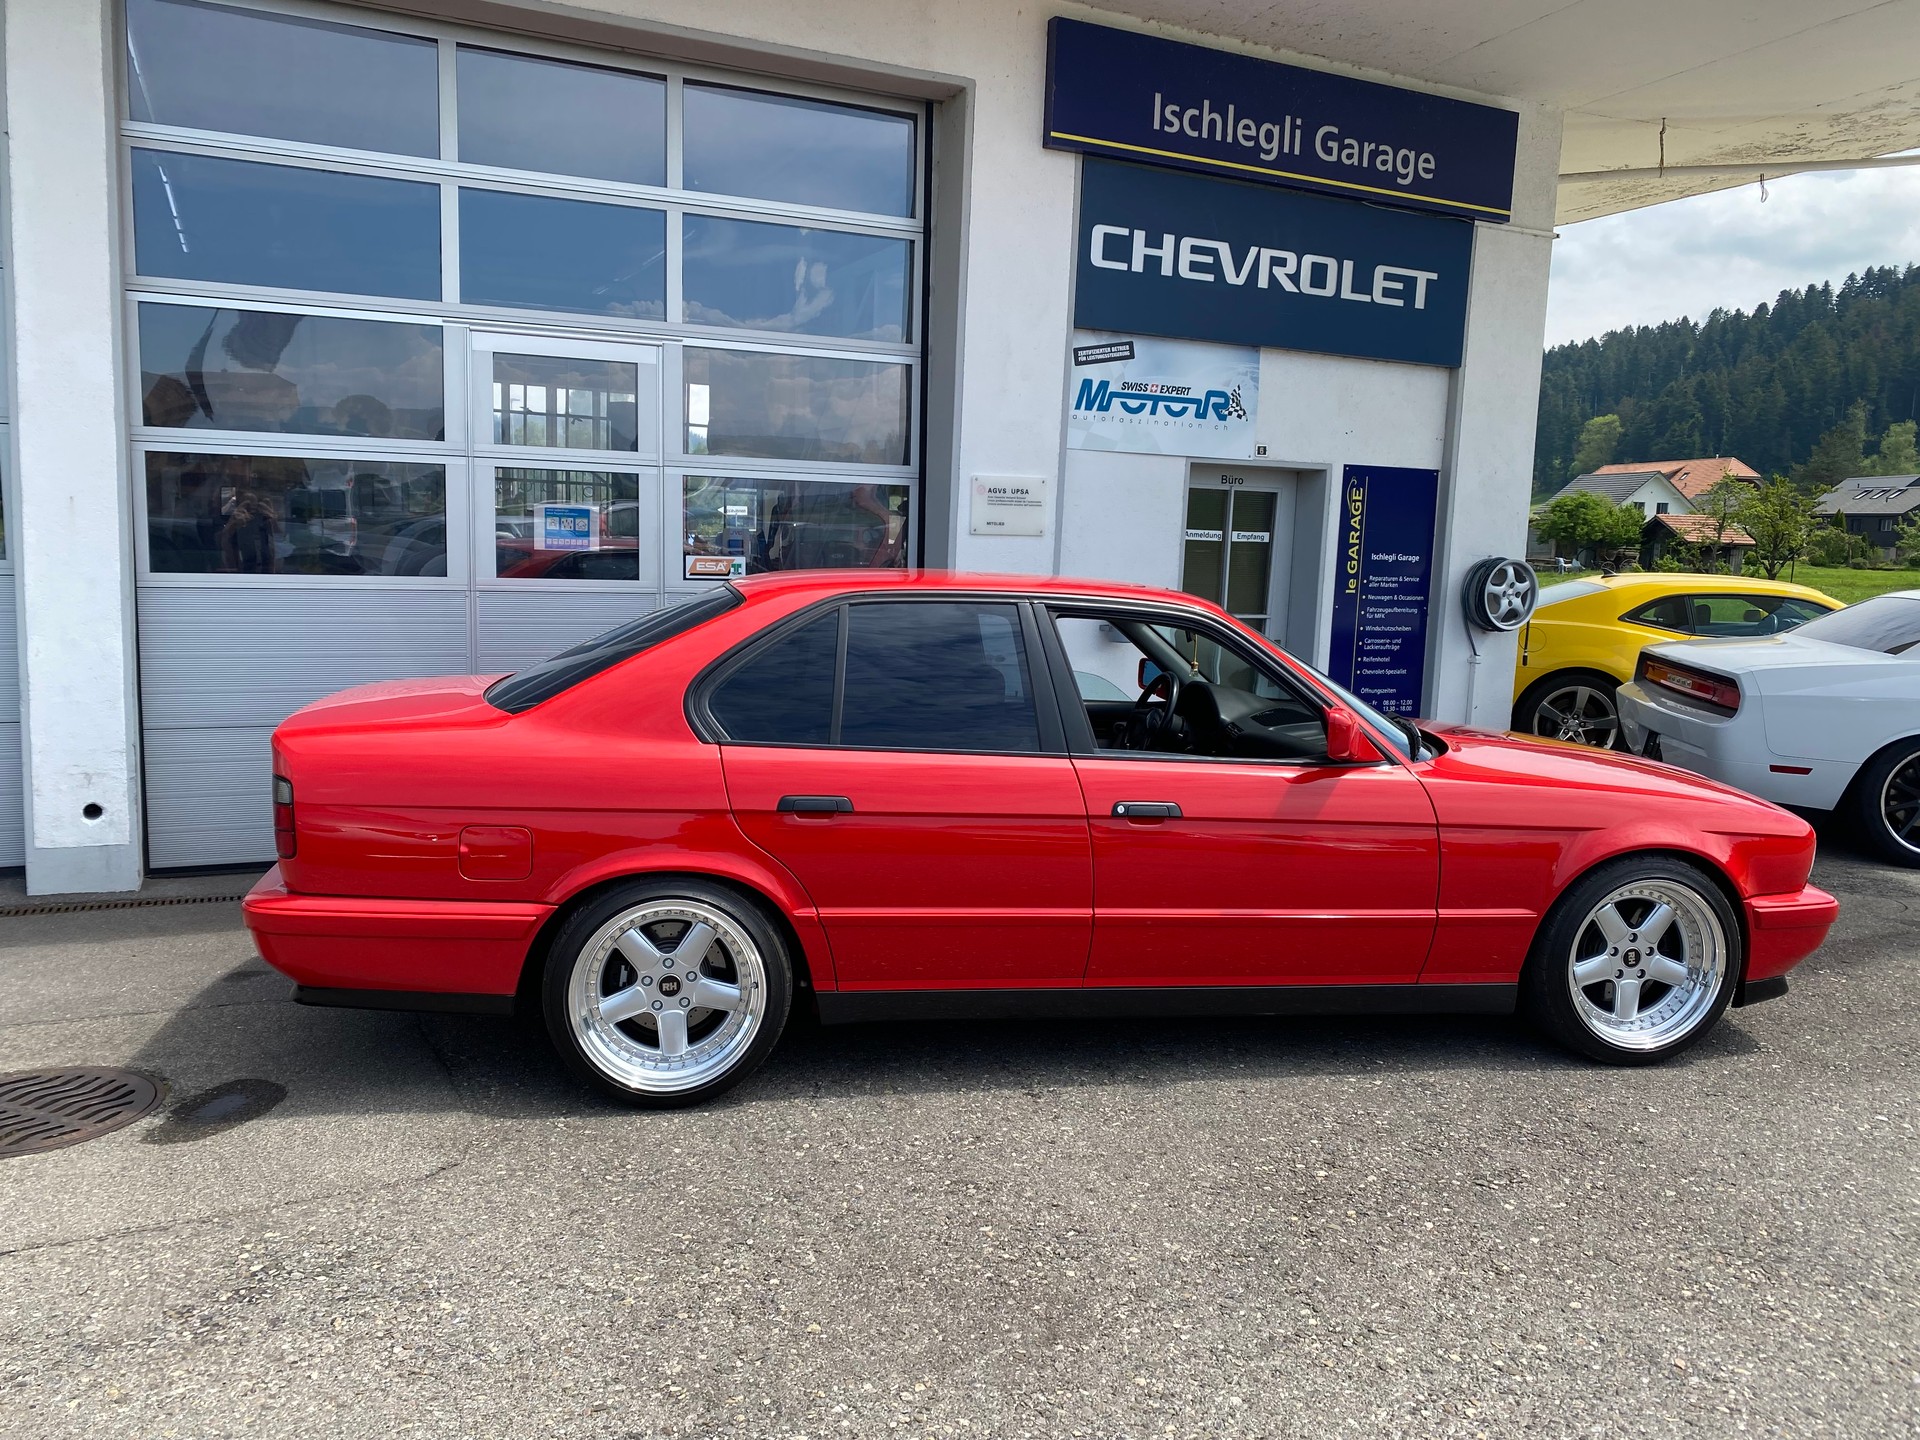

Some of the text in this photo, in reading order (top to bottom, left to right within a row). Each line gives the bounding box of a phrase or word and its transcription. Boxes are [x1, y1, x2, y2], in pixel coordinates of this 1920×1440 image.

[1152, 92, 1436, 185] Ischlegli Garage
[1090, 223, 1438, 310] CHEVROLET
[1121, 381, 1192, 396] SWISS EXPERT
[1221, 474, 1244, 485] Büro
[987, 487, 1007, 495] AGVS
[1185, 530, 1222, 541] Anmeldung
[1236, 532, 1265, 542] Empfang
[1345, 487, 1363, 594] le GARAGE
[1371, 553, 1420, 563] Ischlegli Garage
[1360, 687, 1397, 695] Öffnungszeiten
[1628, 951, 1636, 965] RH
[662, 982, 677, 991] RH
